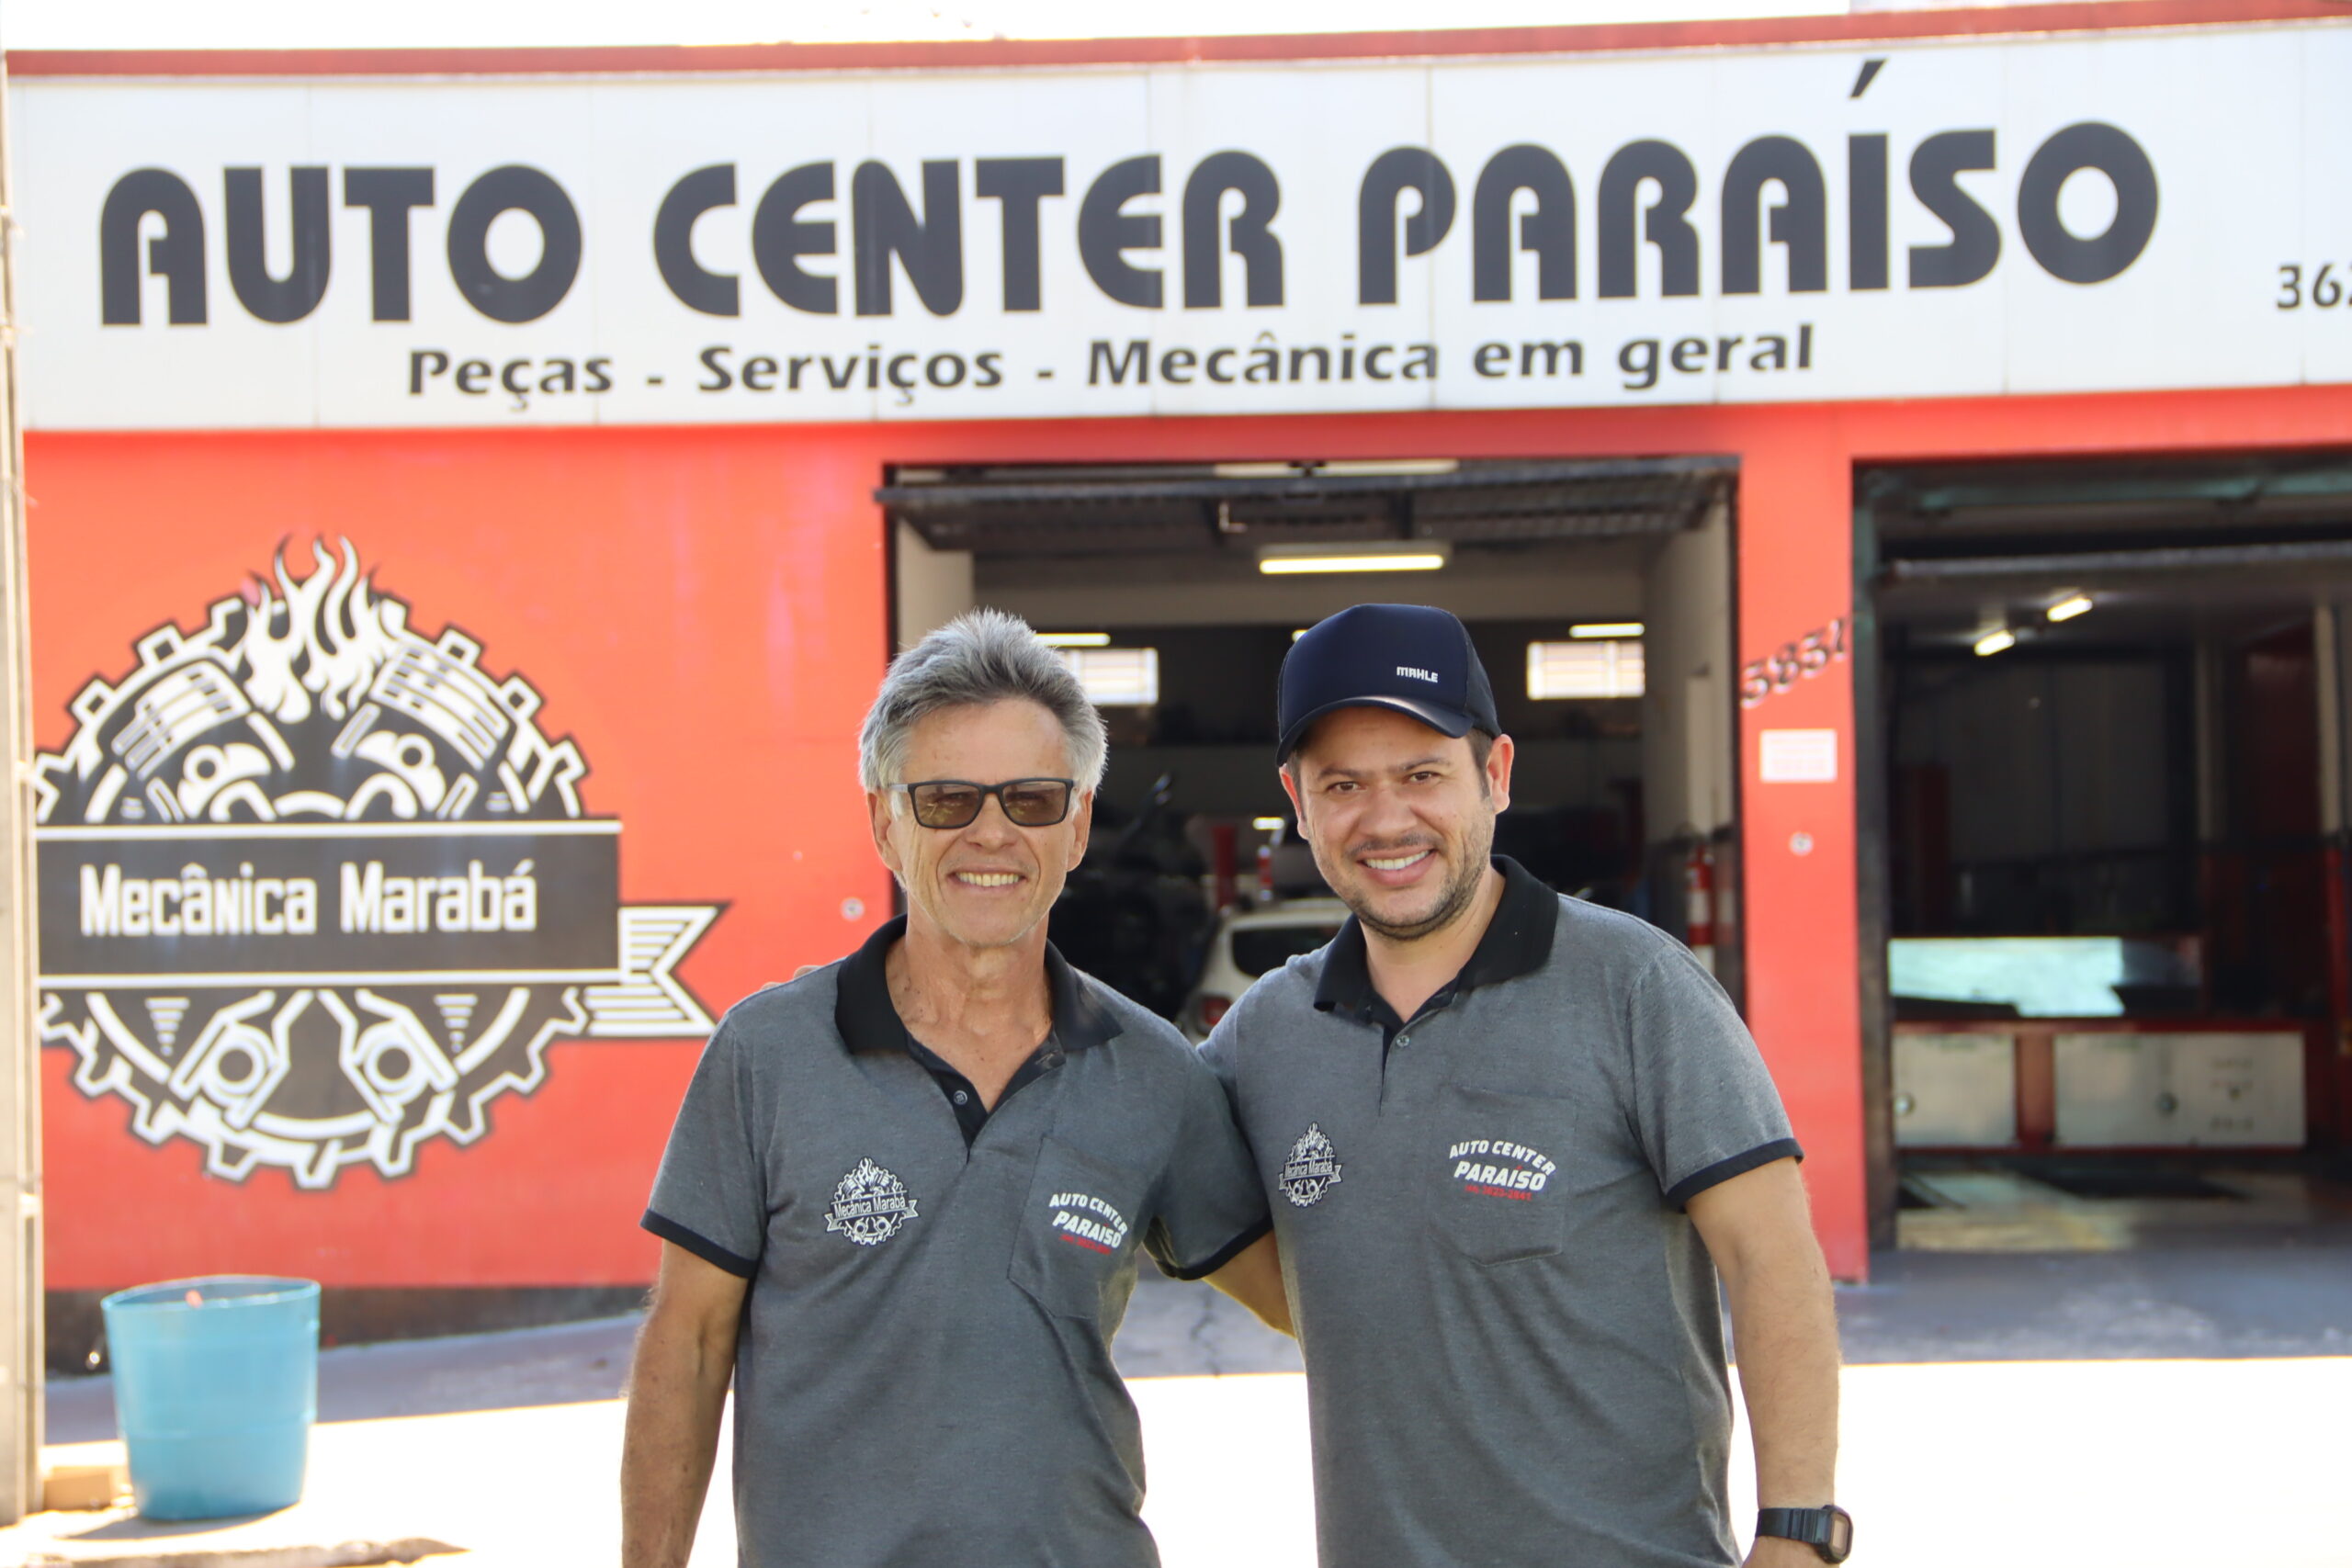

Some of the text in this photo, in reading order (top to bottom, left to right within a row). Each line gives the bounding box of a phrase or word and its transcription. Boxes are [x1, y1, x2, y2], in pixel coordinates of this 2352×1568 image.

[100, 58, 2160, 326] AUTO CENTER PARAÍSO
[2277, 264, 2352, 310] 36
[408, 348, 614, 411] Peças
[697, 344, 1003, 406] Serviços
[1087, 332, 1439, 386] Mecânica
[1472, 338, 1584, 378] em
[1618, 323, 1815, 390] geral
[1396, 666, 1439, 683] MAHLE
[80, 860, 537, 936] Mecânica Marabá
[1449, 1140, 1556, 1176] AUTO CENTER
[1048, 1192, 1128, 1235] AUTO CENTER
